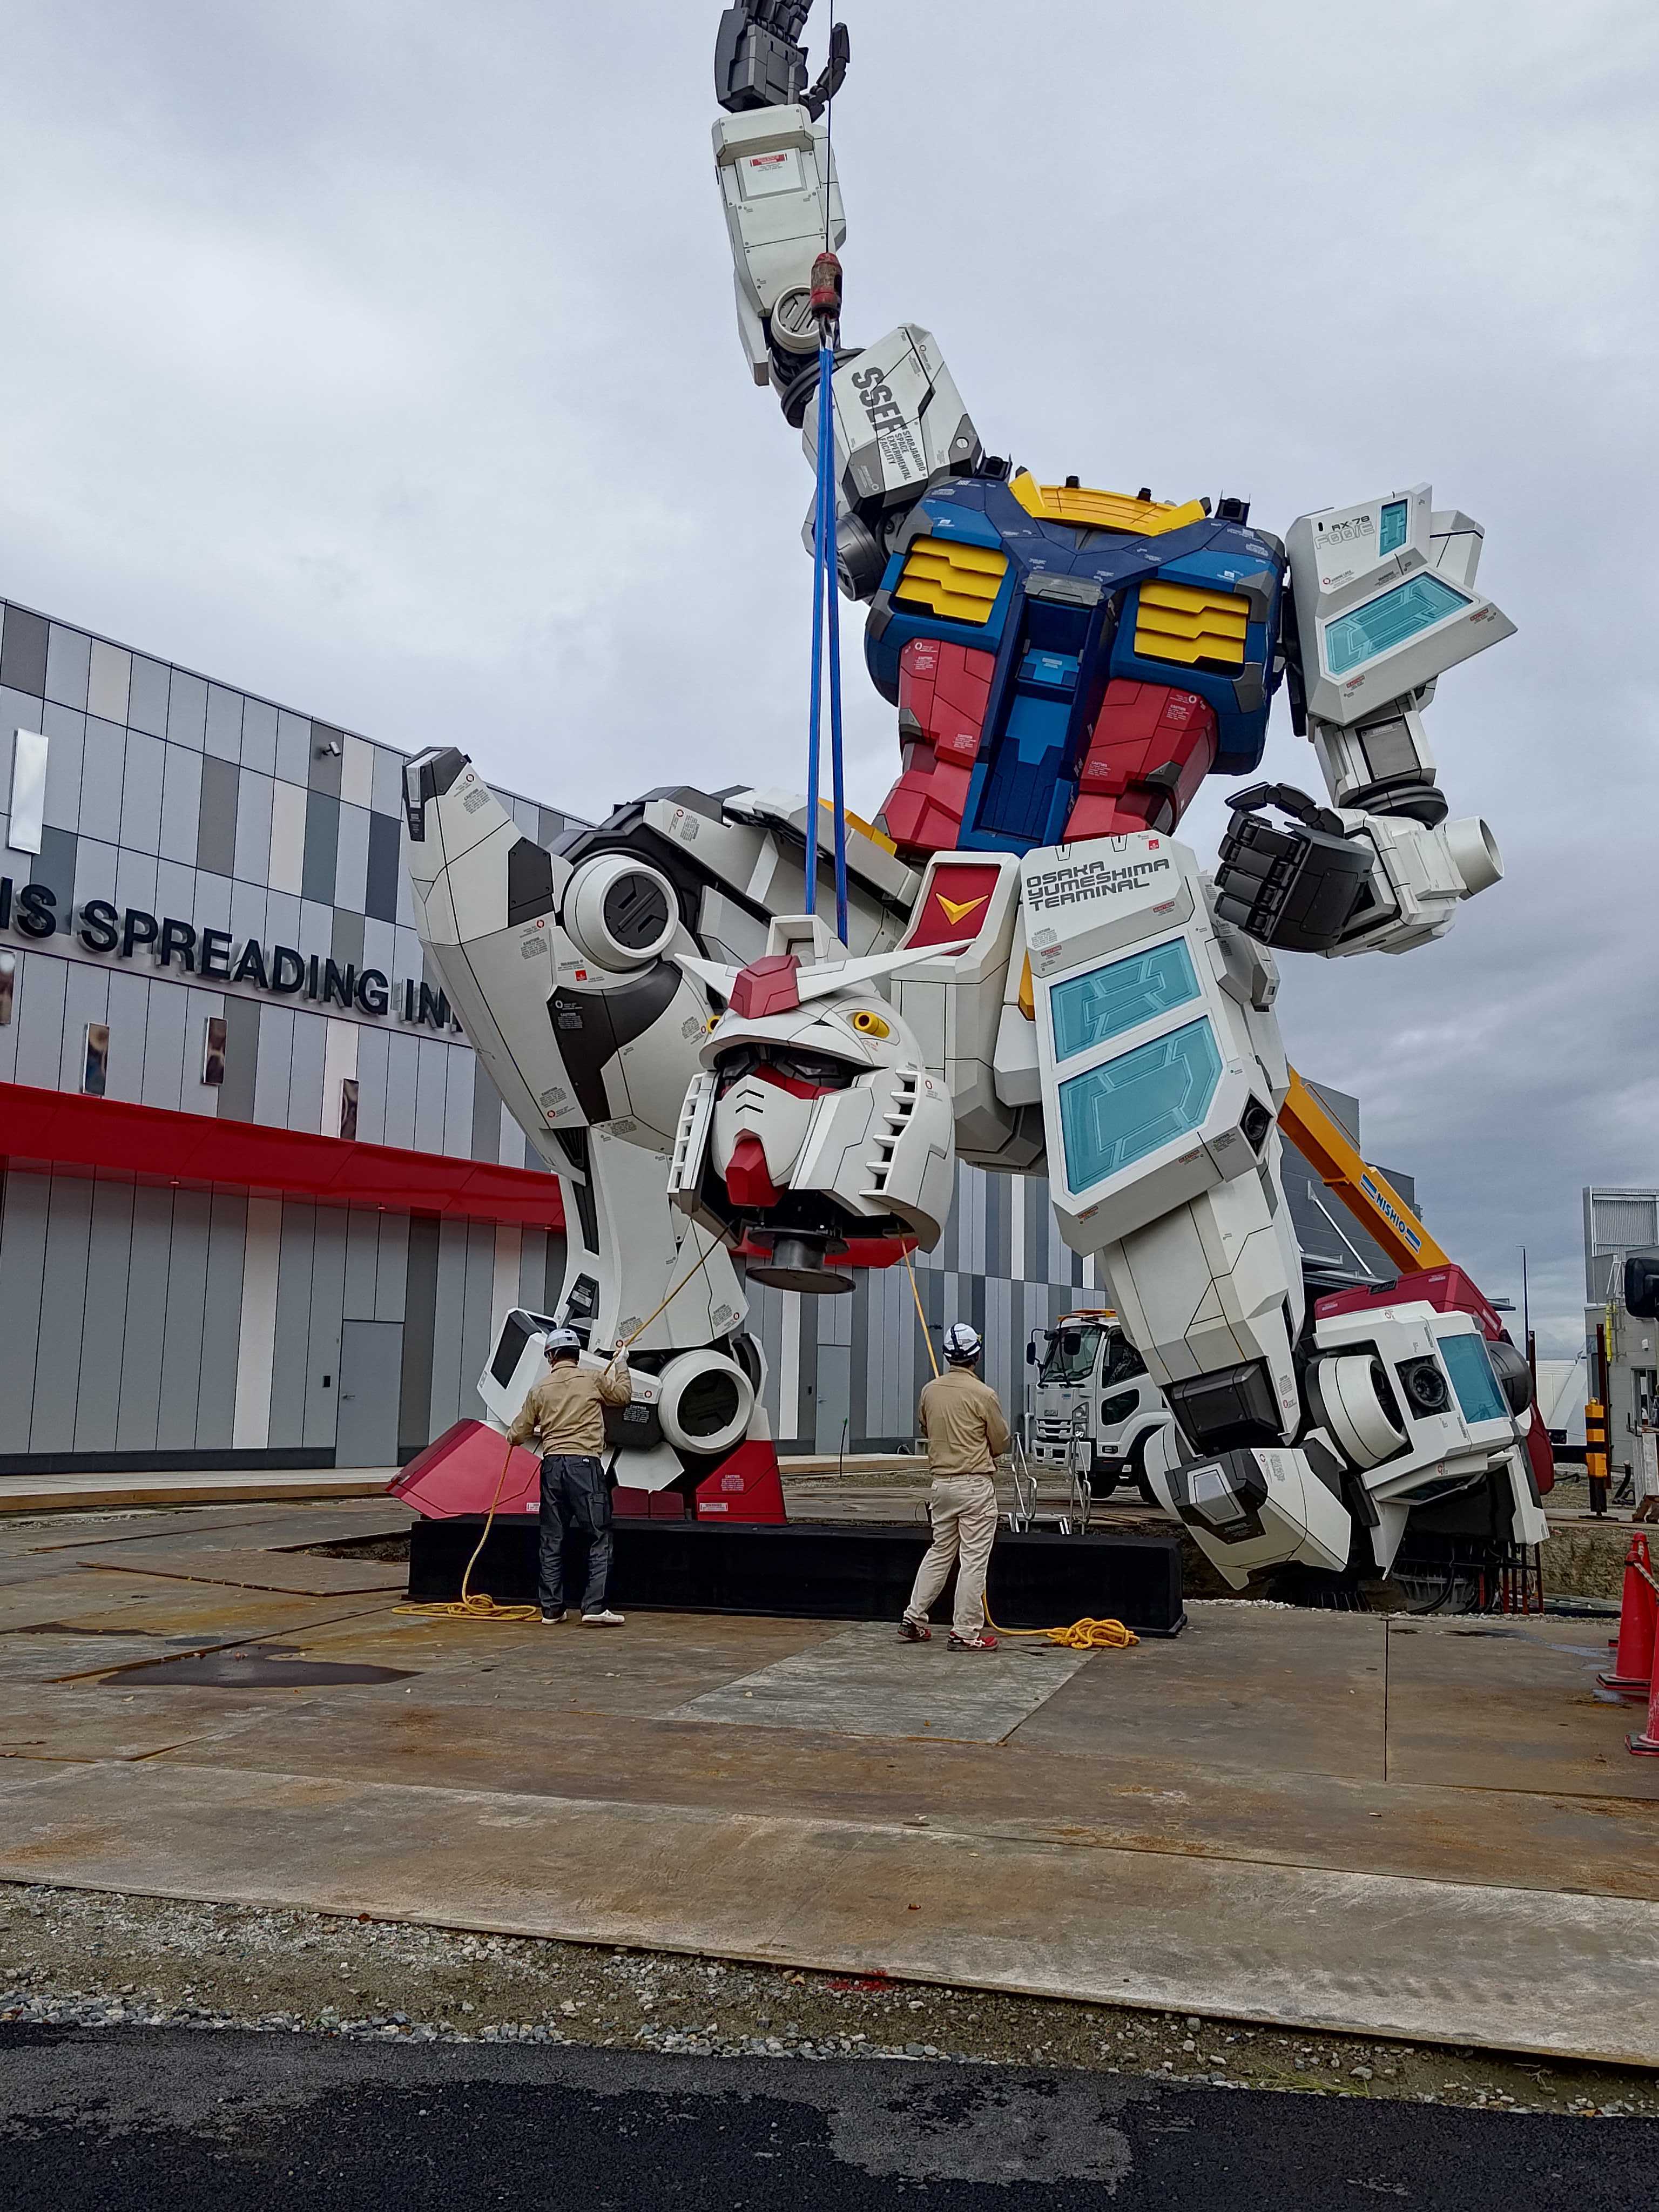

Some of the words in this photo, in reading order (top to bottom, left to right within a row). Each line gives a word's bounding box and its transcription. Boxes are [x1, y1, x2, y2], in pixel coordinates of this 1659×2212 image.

[852, 367, 908, 432] SSEF
[880, 437, 896, 464] FACILITY
[887, 435, 912, 481] EXPERIMENTAL
[895, 433, 909, 454] SPACE
[1027, 861, 1105, 888] OSAKA
[1028, 858, 1170, 900] YUMESHIMA
[1029, 878, 1150, 912] TERMINAL
[80, 899, 389, 1016] SPREADING
[405, 978, 463, 1033] IN
[1376, 1192, 1406, 1233] NISHIO
